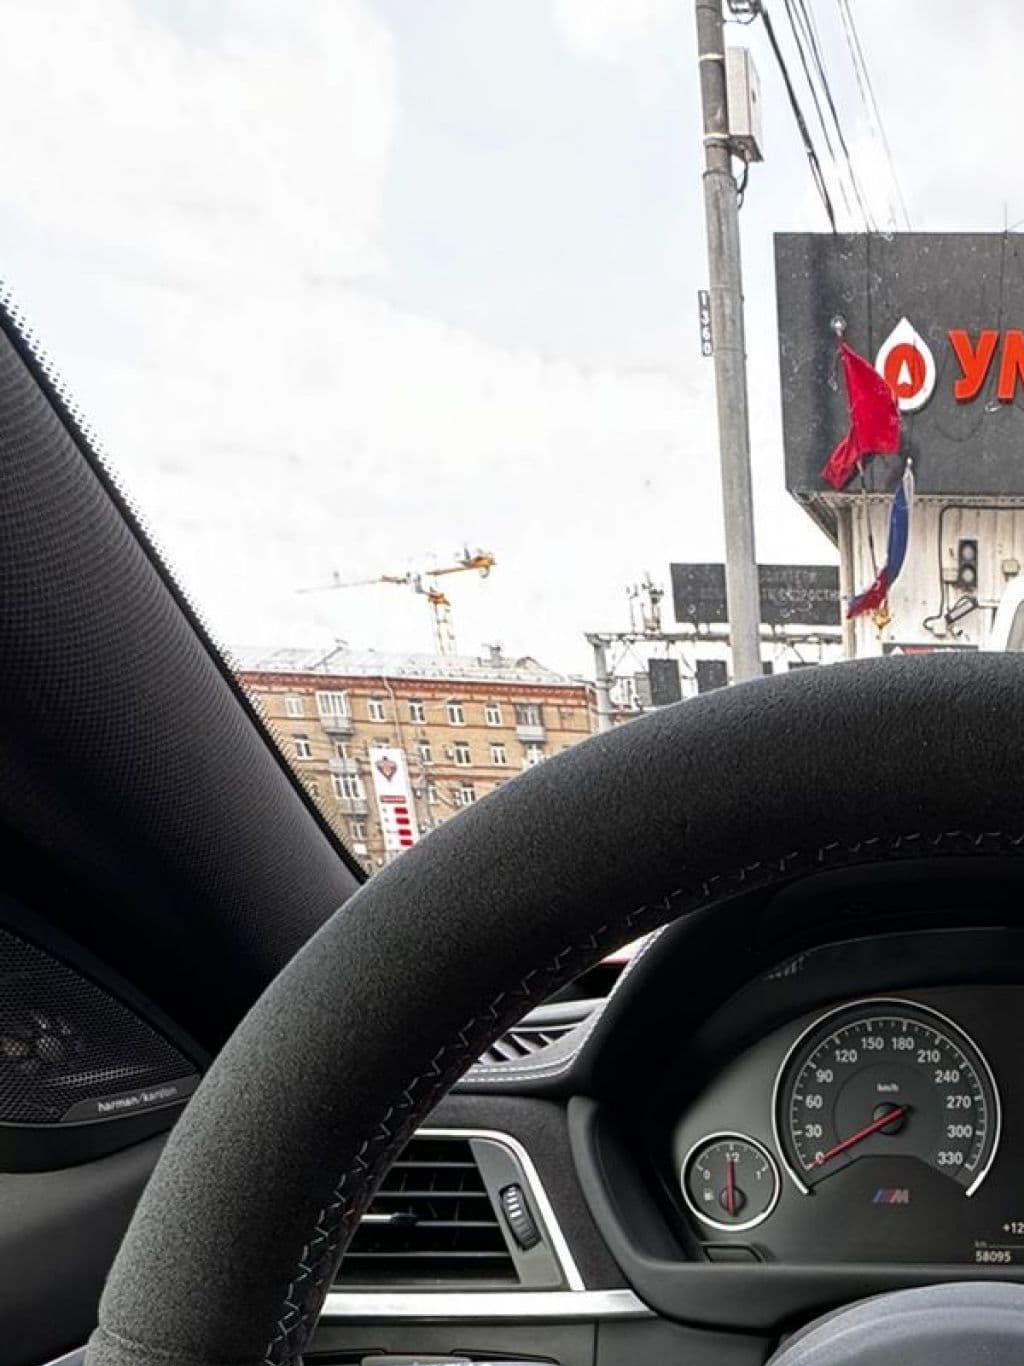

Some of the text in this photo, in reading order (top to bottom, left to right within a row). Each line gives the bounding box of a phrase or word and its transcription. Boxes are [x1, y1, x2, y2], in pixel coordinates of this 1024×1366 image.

[861, 1037, 884, 1049] 150
[891, 1037, 914, 1050] 180
[835, 1050, 857, 1063] 120
[917, 1050, 941, 1063] 210
[816, 1069, 833, 1083] 90
[935, 1069, 959, 1083] 240
[805, 1095, 823, 1109] 60
[946, 1095, 971, 1109] 270
[805, 1124, 822, 1138] 30
[947, 1125, 972, 1138] 300
[938, 1151, 963, 1165] 330
[703, 1169, 711, 1180] 0
[975, 1251, 1011, 1263] 58095
